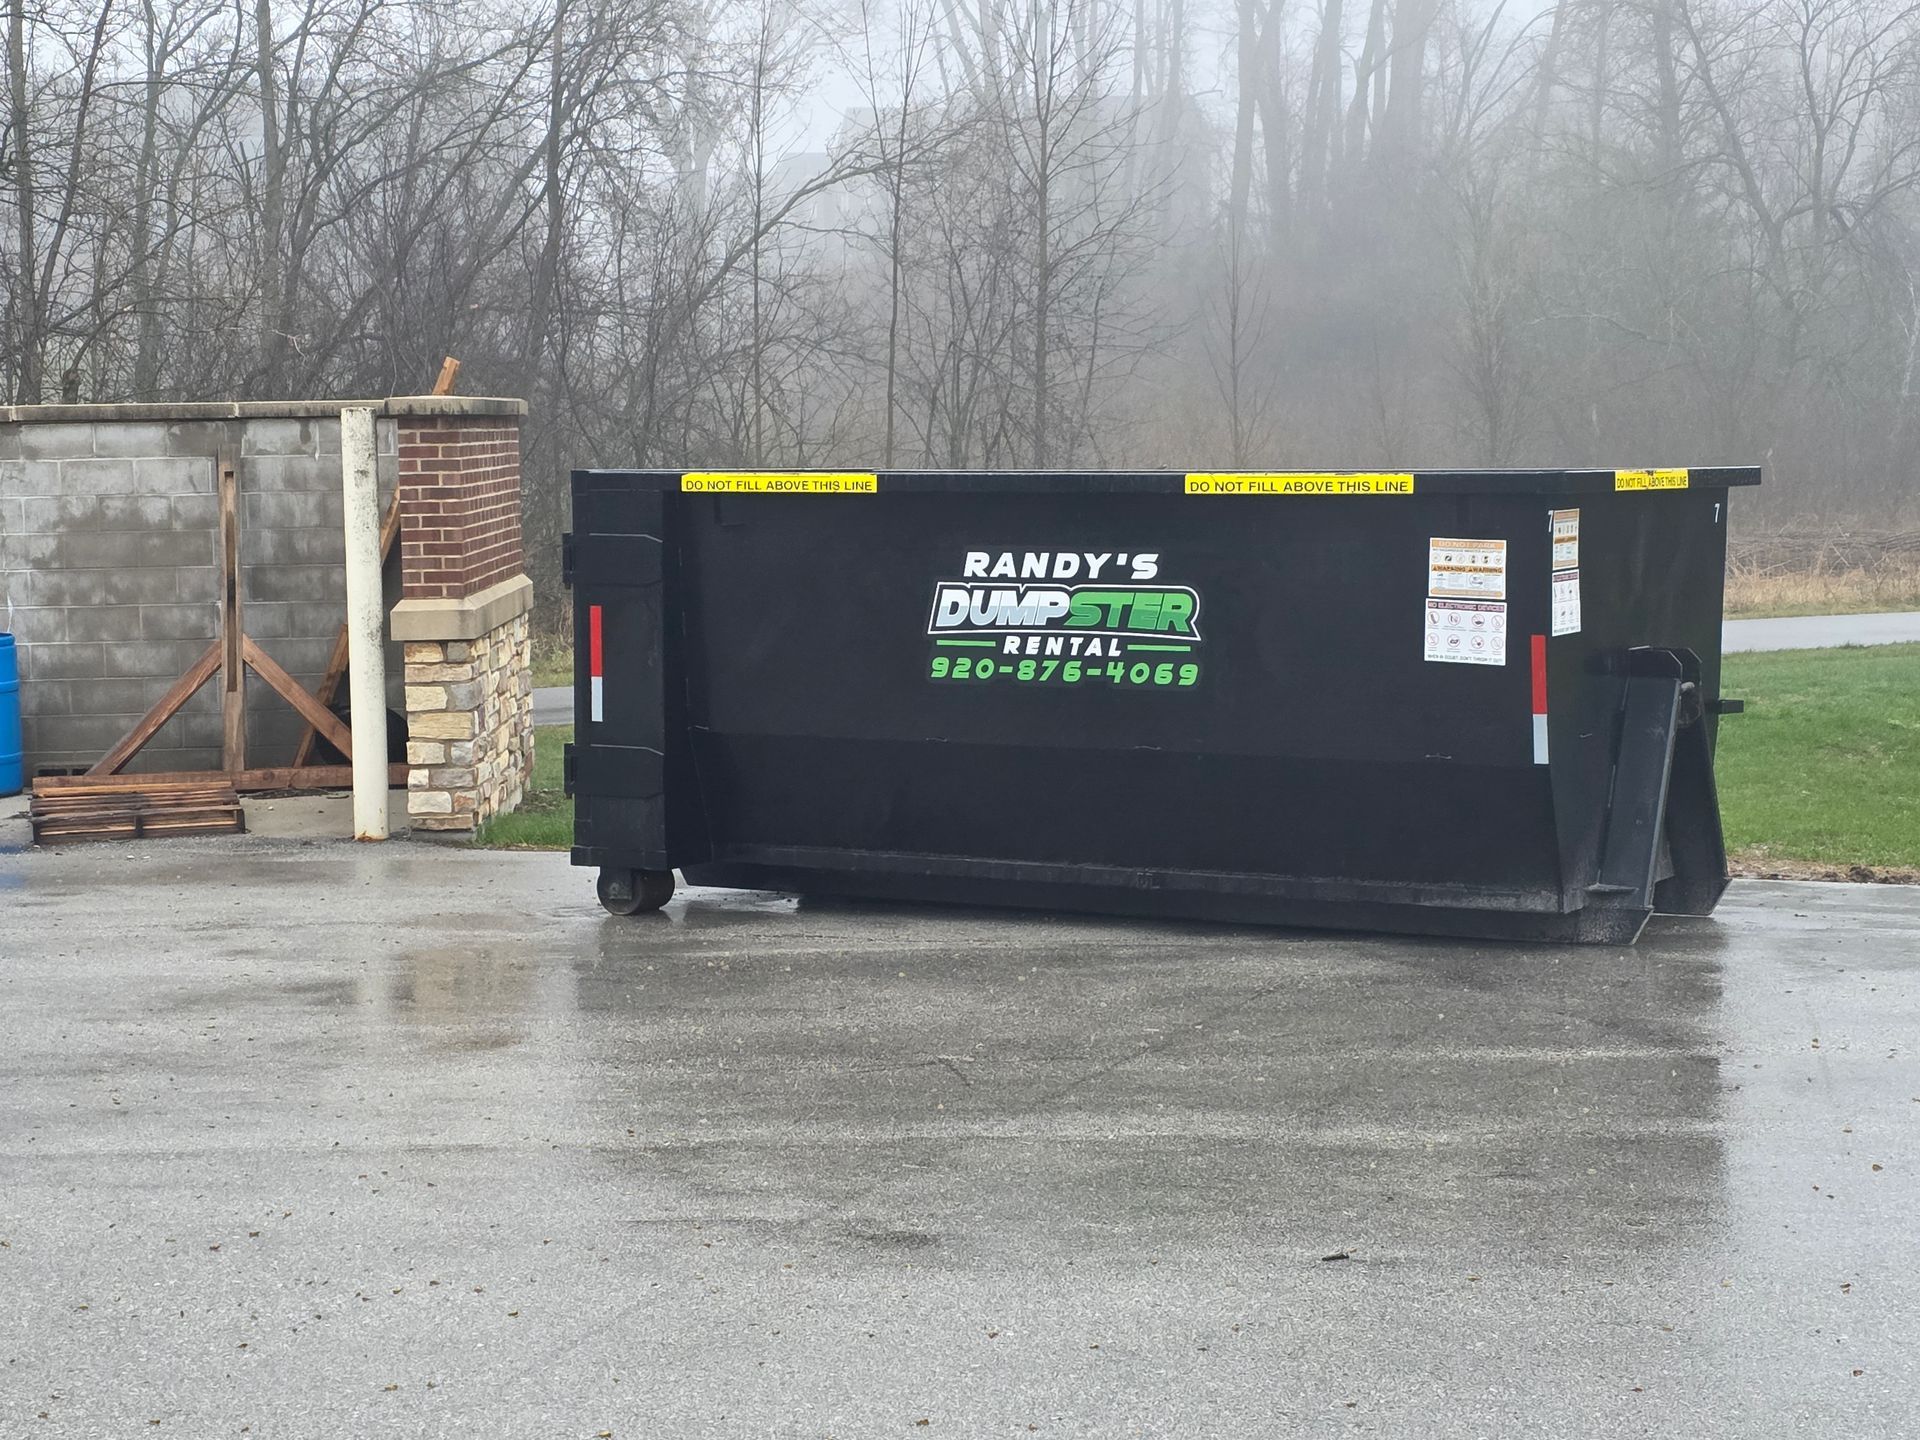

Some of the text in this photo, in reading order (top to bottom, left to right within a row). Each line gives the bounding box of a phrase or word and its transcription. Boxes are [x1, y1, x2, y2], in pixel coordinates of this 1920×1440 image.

[686, 480, 872, 490] DO NOT FILL ABOVE THIS LINE
[1190, 481, 1408, 491] DO NOT FILL ABOVE THIS LINE
[1617, 476, 1687, 488] DO NOT FILL ABOVE THIS LINE
[1548, 510, 1554, 533] 7
[1714, 503, 1720, 523] 7
[963, 551, 1159, 579] RANDY'S
[935, 588, 1193, 632] DUMPSTER
[1003, 635, 1122, 656] RENTAL
[930, 656, 1199, 686] 920-876-4069
